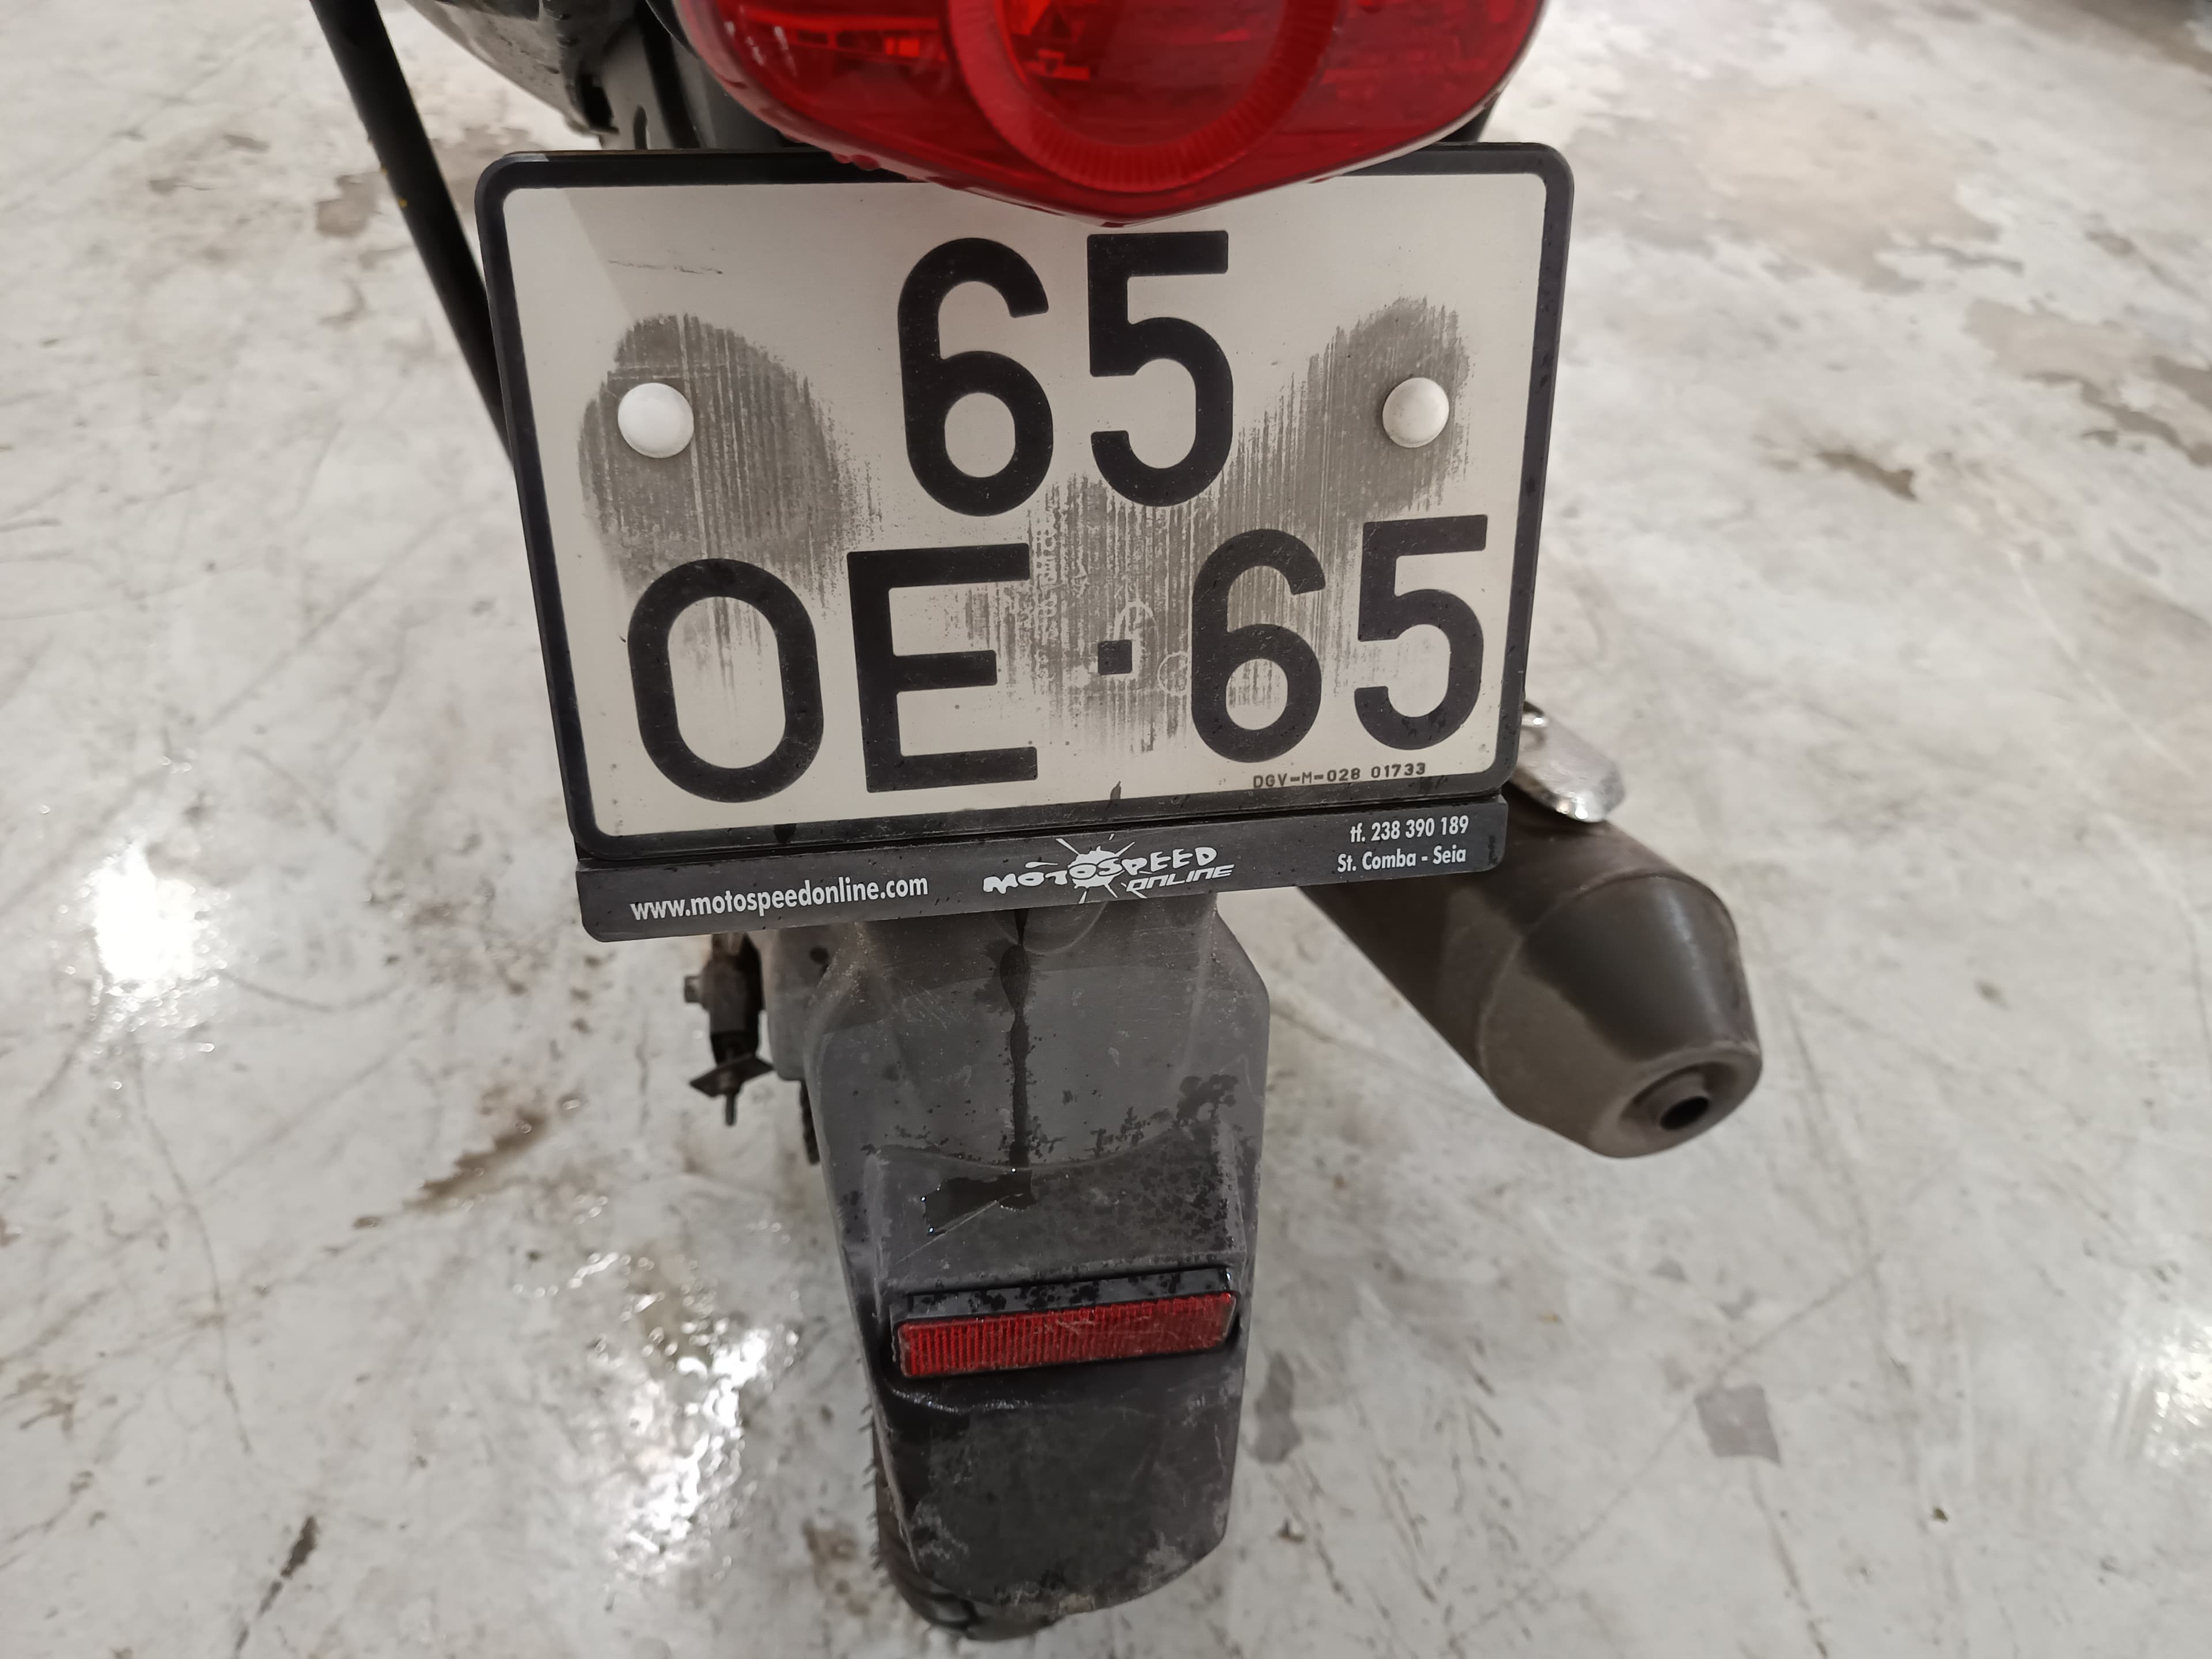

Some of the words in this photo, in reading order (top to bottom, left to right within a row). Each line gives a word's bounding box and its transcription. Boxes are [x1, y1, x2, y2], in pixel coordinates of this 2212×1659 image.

[897, 230, 1234, 517] 65
[1252, 767, 1361, 789] DGV-M-028
[1370, 762, 1426, 779] 01733
[1370, 820, 1400, 841] 238
[1405, 817, 1435, 838] 390
[1441, 815, 1469, 835] 189
[983, 847, 1217, 894] MOTOSPEED
[1337, 853, 1357, 873] St.
[1362, 848, 1416, 870] Comba
[1433, 844, 1467, 864] Seia
[630, 876, 929, 921] www.motospeedonline.com
